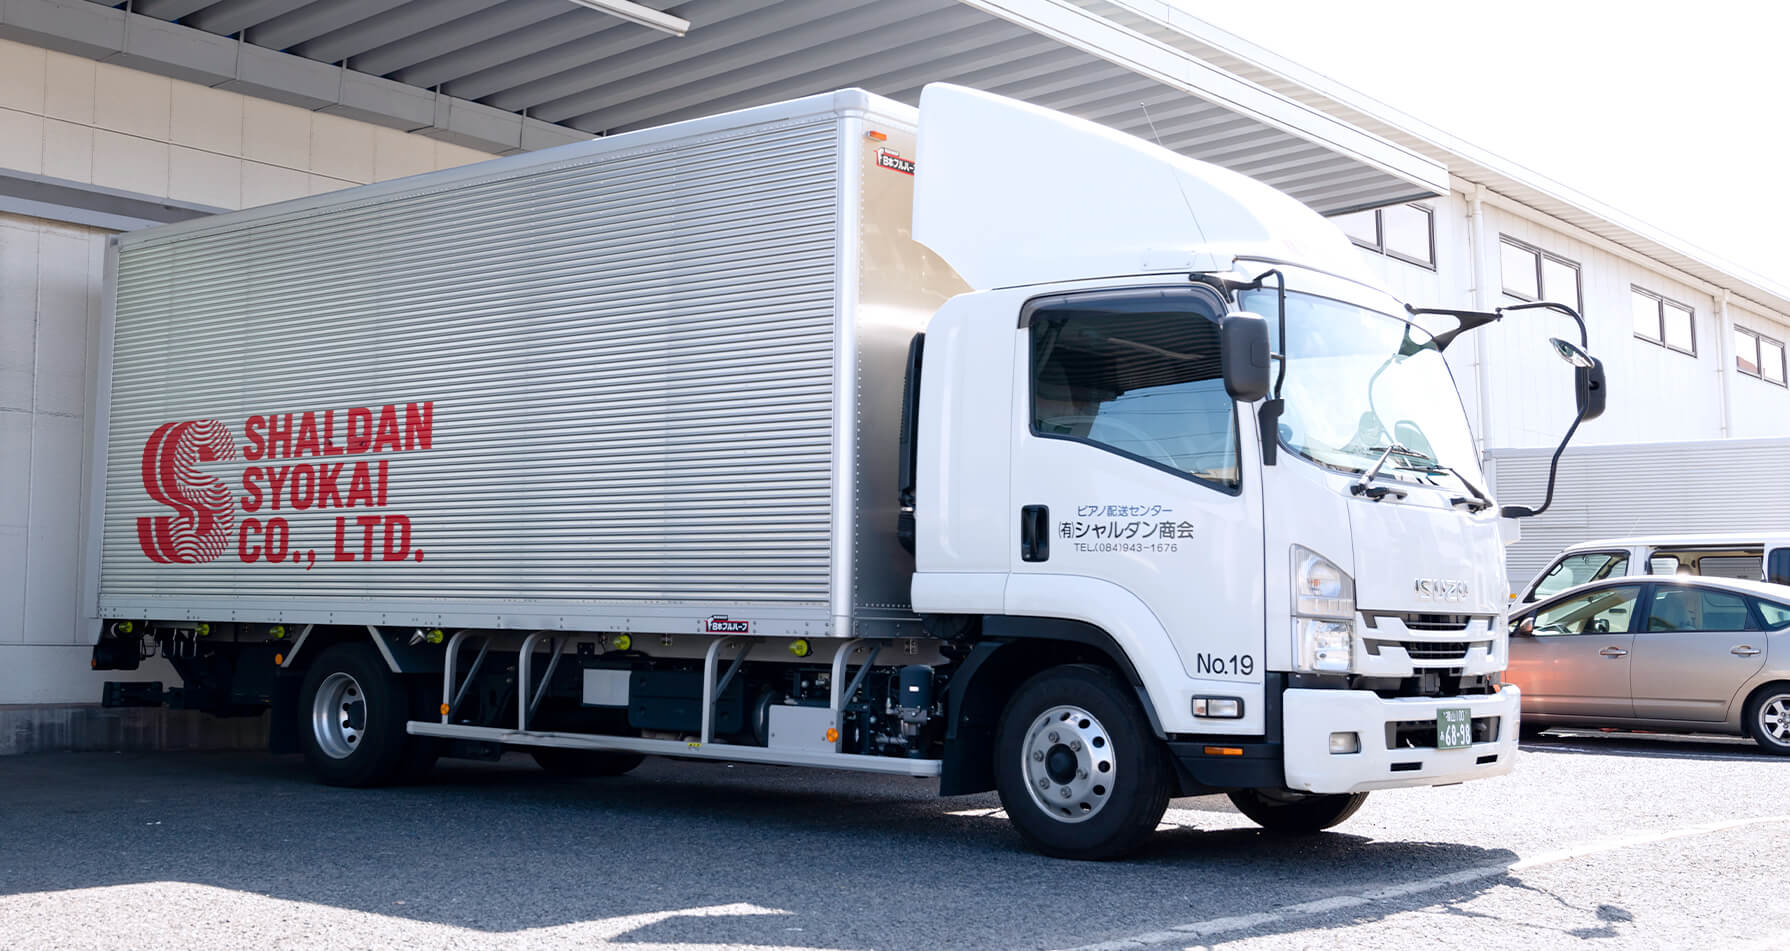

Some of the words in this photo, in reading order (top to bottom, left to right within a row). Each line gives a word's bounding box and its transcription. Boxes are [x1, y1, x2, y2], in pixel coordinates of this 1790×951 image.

[882, 155, 915, 172] 日本フルハー
[243, 401, 434, 461] SHALDAN
[241, 460, 388, 512] SYOKAI
[1077, 504, 1173, 517] ピアノ配送センター
[238, 517, 316, 571] CO.,
[334, 515, 424, 563] LTD.
[1414, 578, 1469, 601] ISUZU
[711, 622, 748, 631] 日本フルハーフ
[1197, 653, 1254, 676] No.19
